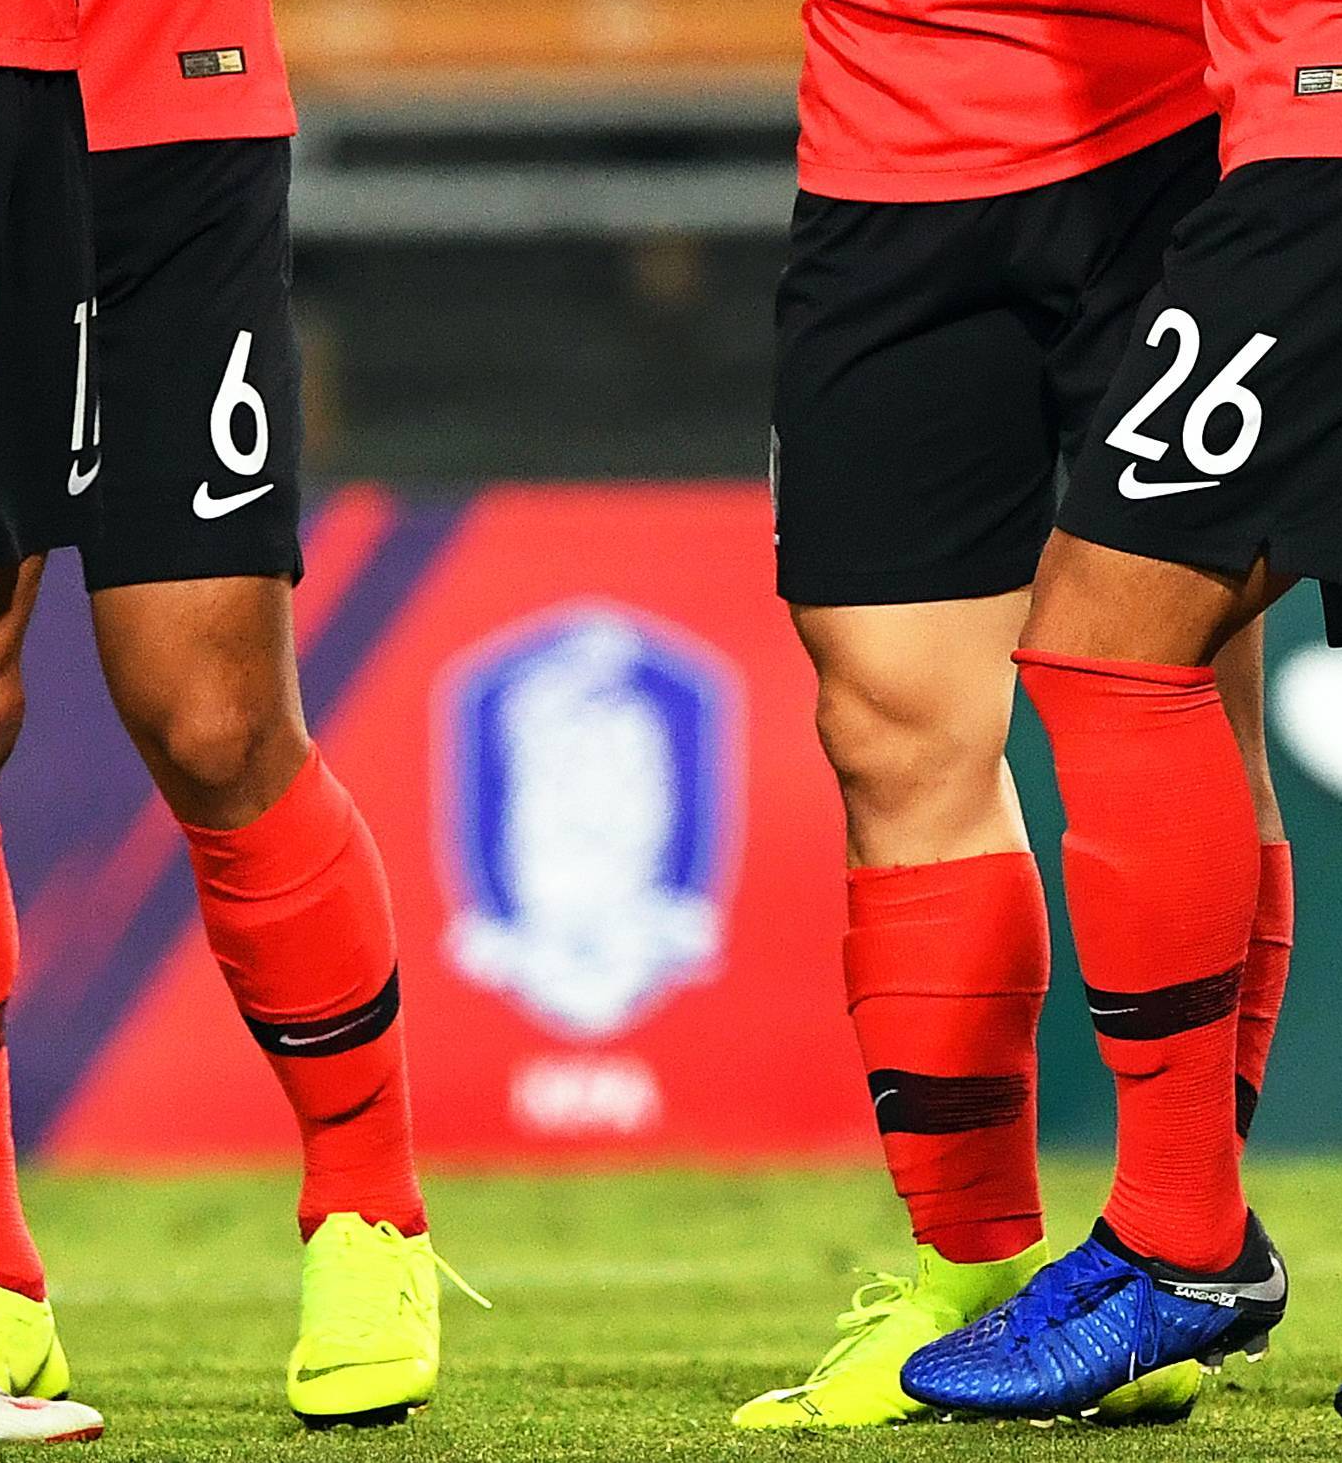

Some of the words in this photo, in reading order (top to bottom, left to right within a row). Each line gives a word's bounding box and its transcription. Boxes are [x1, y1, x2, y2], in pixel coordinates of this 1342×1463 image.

[210, 330, 269, 476] 6
[1105, 308, 1278, 476] 26
[1174, 1286, 1220, 1303] SANGHO
